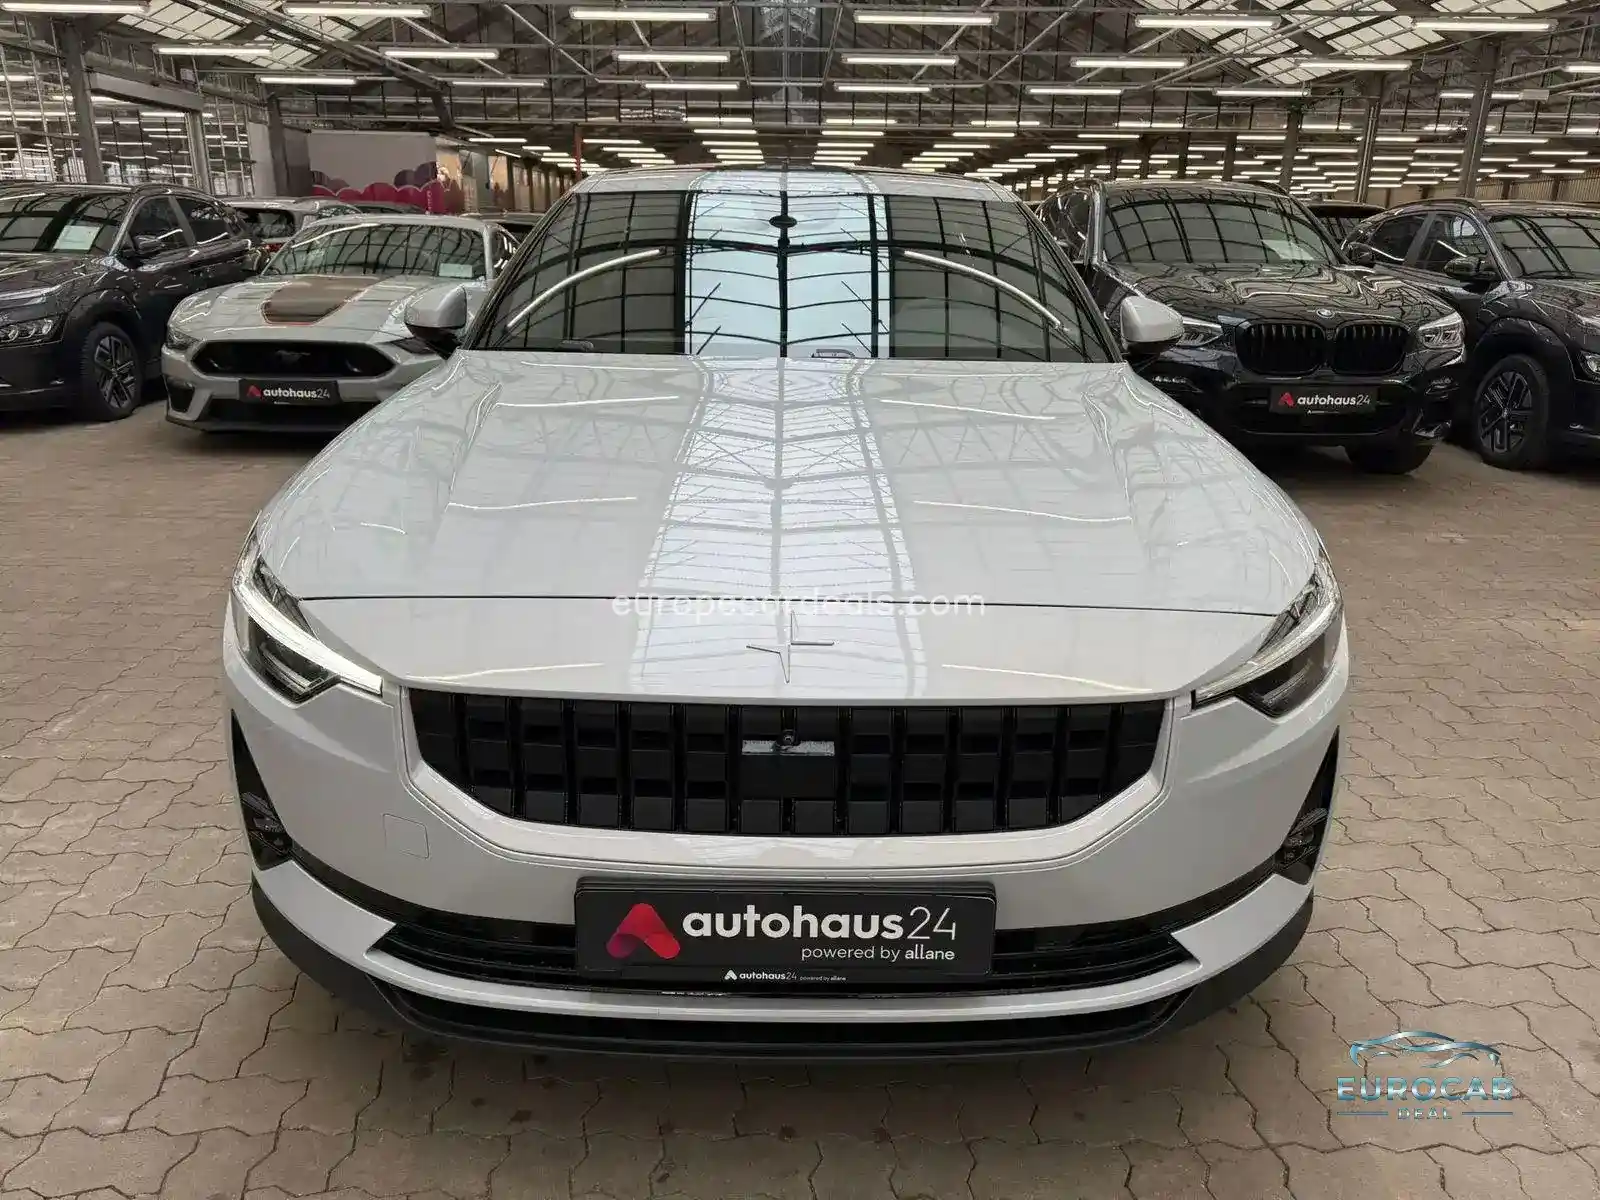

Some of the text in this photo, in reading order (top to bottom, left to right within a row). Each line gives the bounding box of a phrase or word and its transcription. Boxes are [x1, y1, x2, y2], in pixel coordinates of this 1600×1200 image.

[263, 387, 330, 399] autohaus24
[1297, 394, 1371, 406] autohaus24
[682, 904, 956, 940] autohaus24
[801, 943, 956, 962] powered by allane
[739, 972, 797, 980] autohaus24
